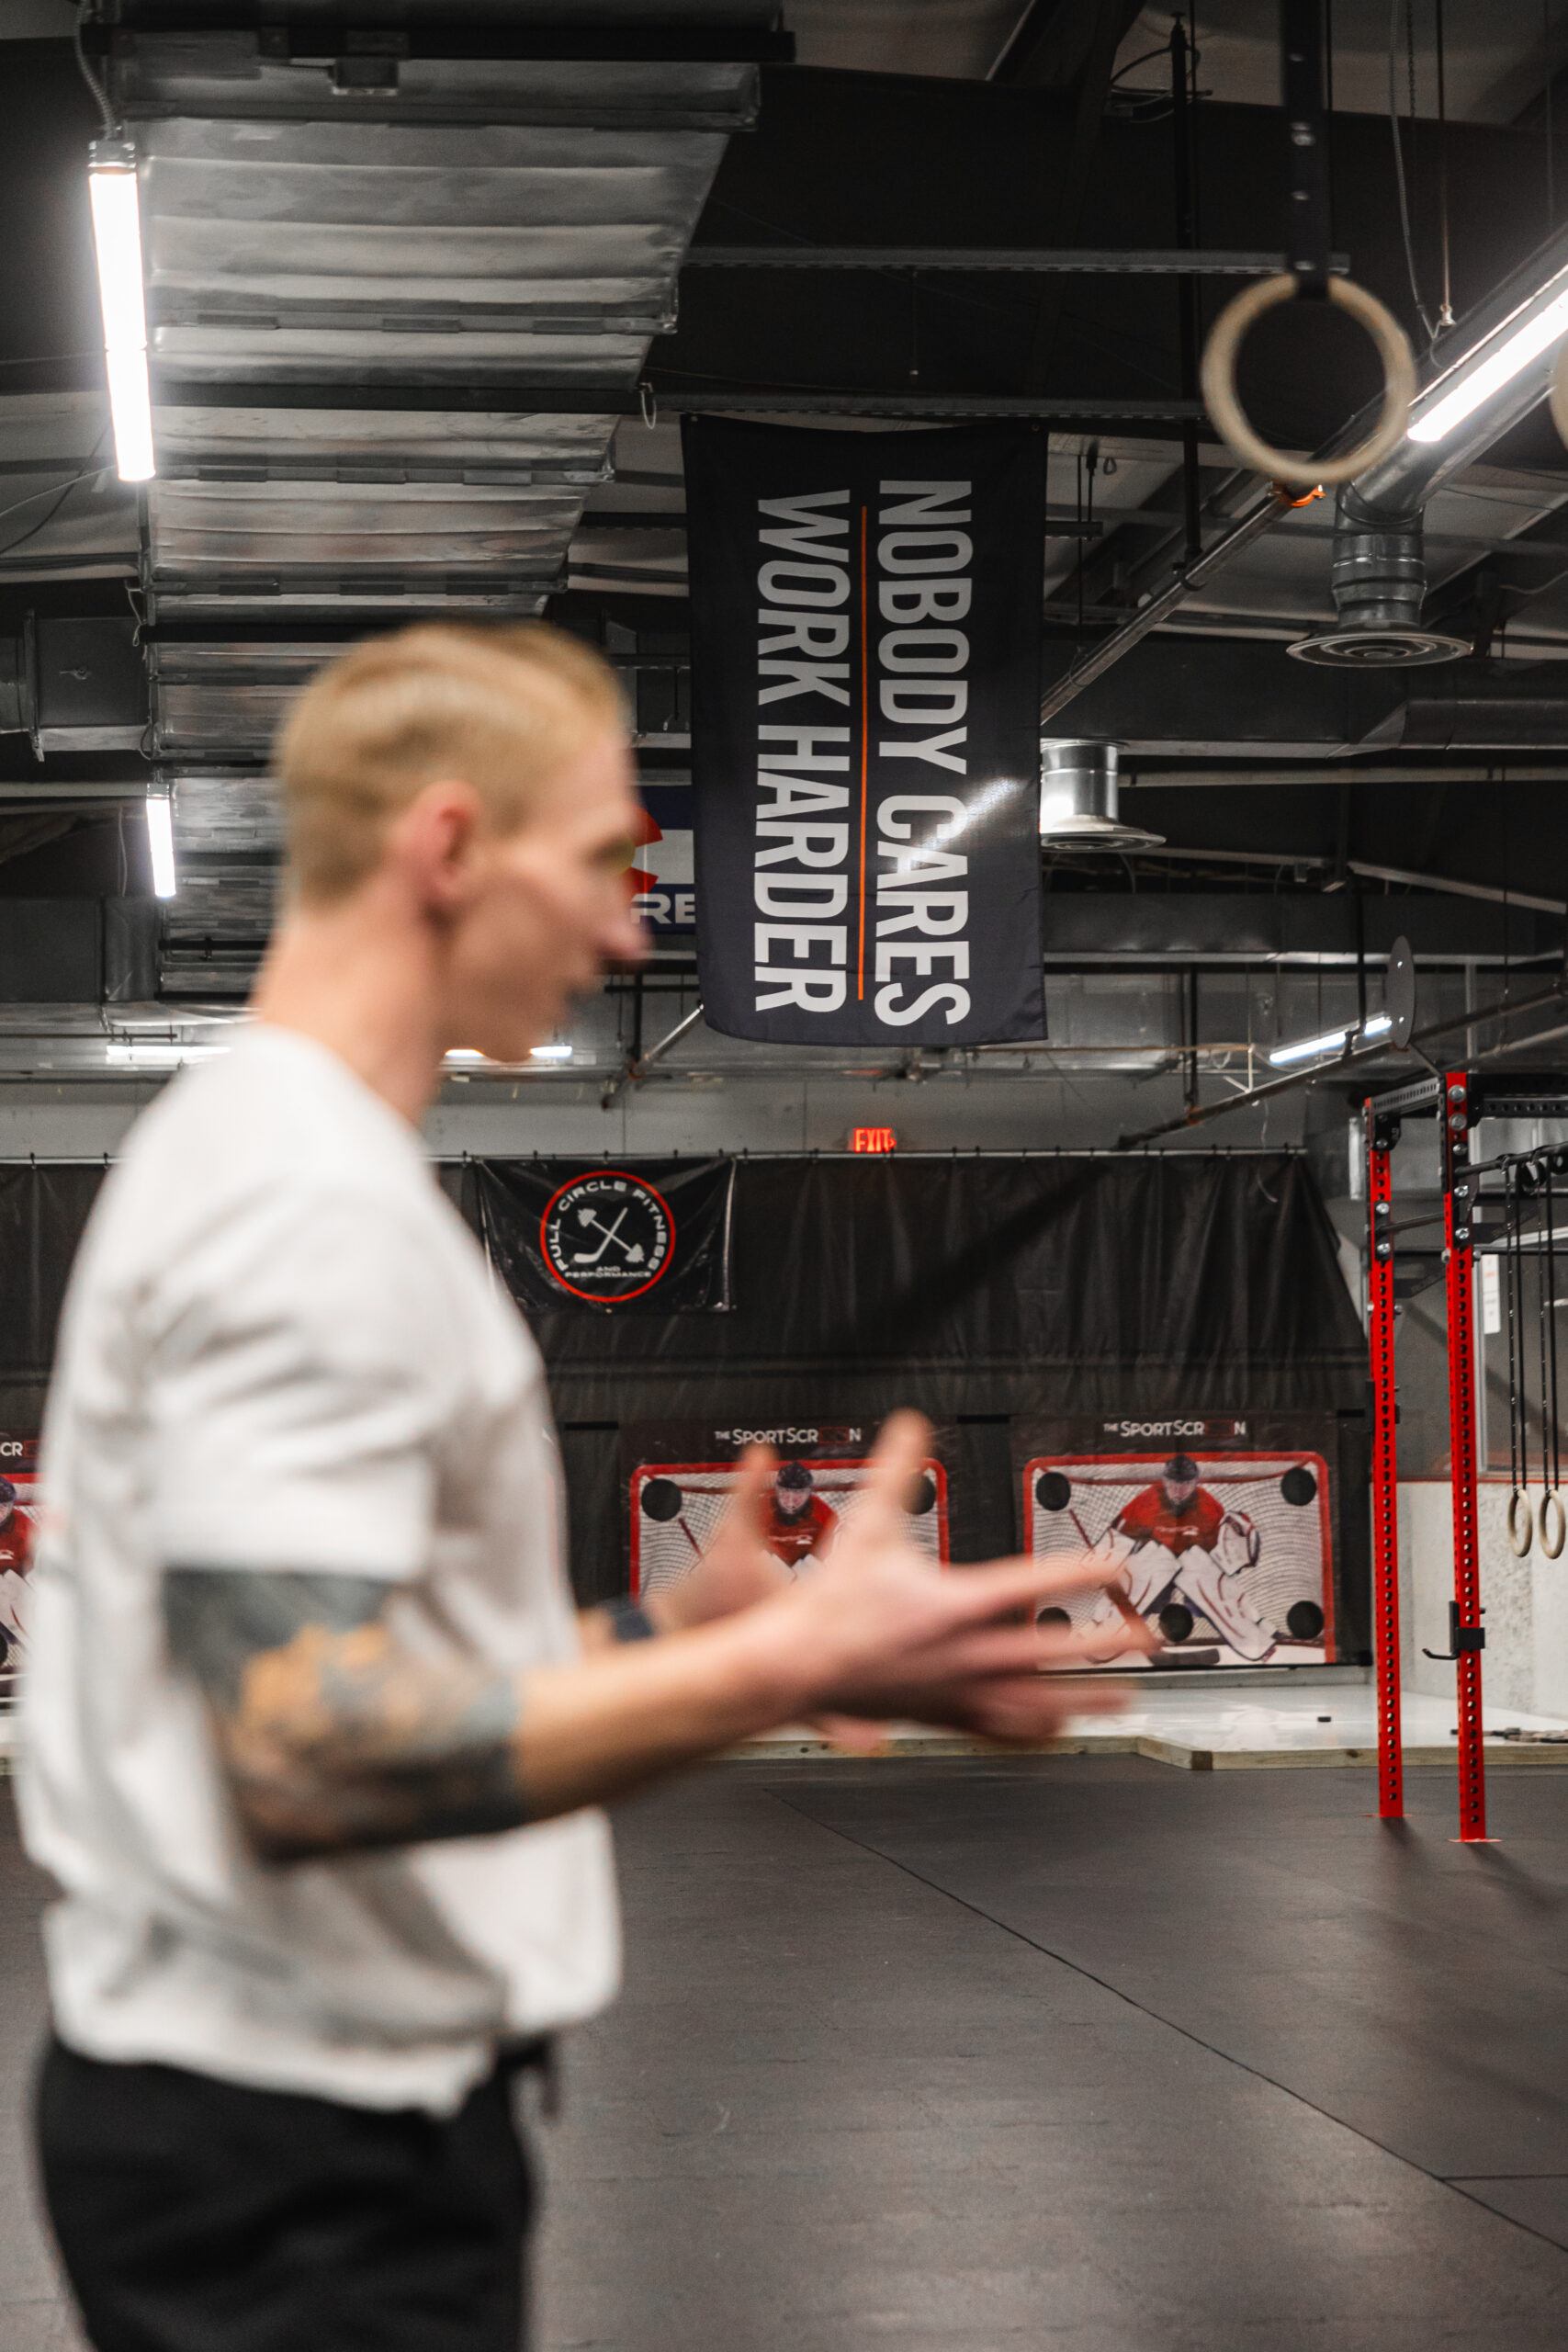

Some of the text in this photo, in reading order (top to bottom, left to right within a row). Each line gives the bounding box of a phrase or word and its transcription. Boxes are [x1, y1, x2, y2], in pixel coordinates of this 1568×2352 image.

[753, 489, 851, 1012] WORK HARDER
[874, 480, 973, 1026] NOBODY CARES
[549, 1180, 667, 1272] FULL CIRCLE FITNESS
[853, 1127, 892, 1153] EXIT
